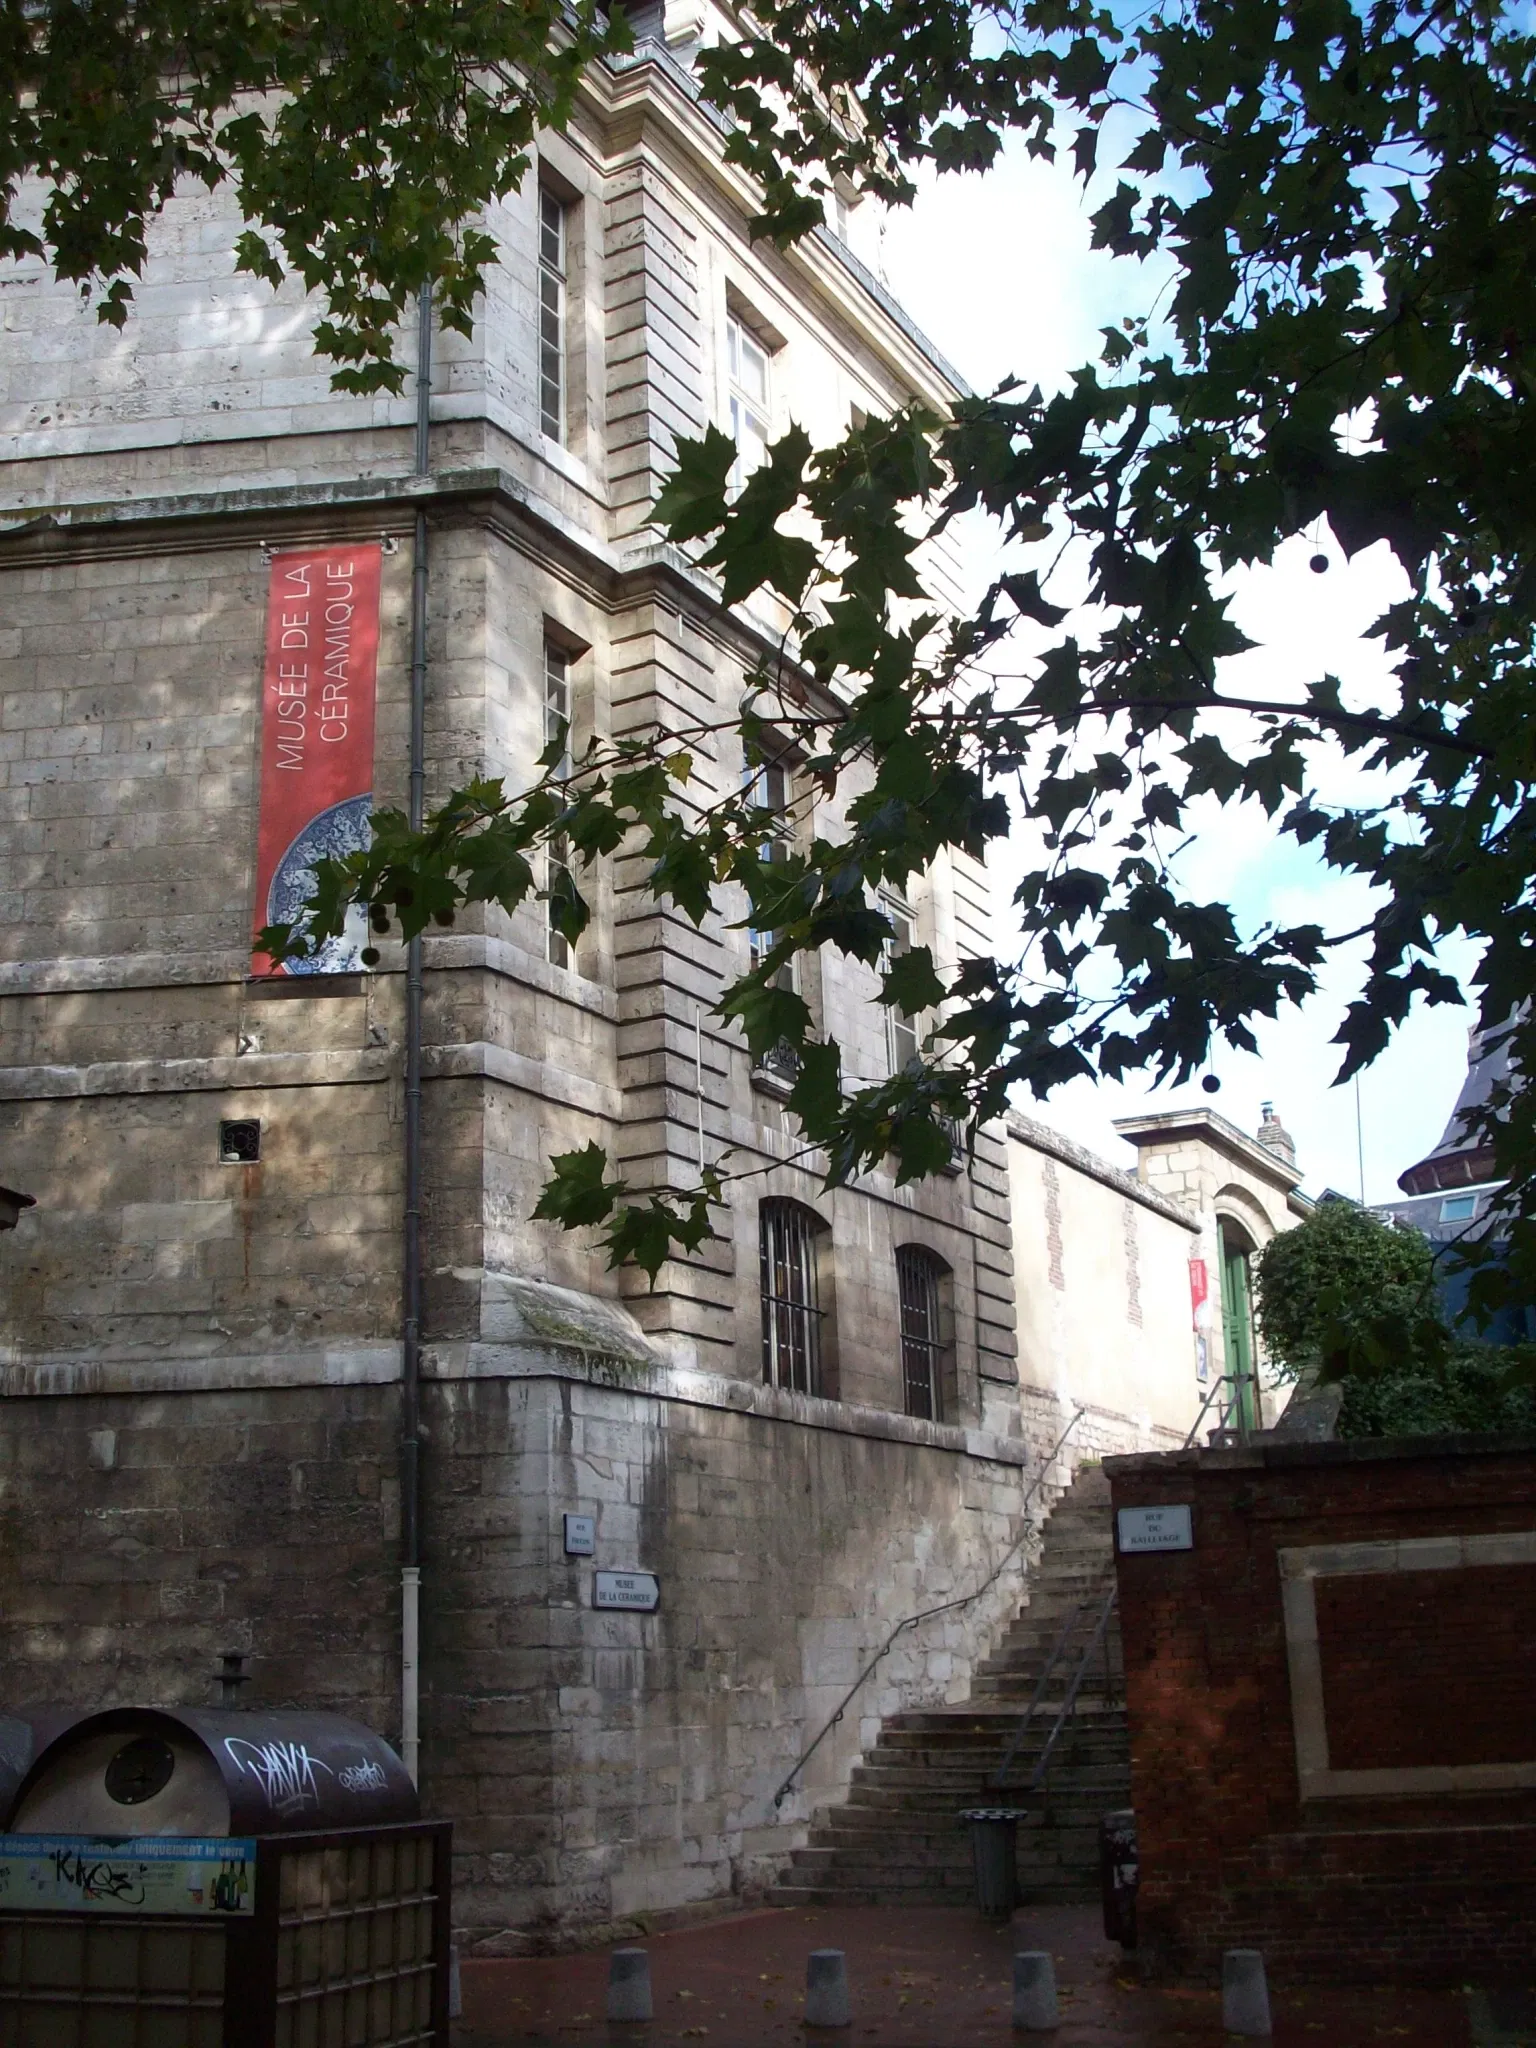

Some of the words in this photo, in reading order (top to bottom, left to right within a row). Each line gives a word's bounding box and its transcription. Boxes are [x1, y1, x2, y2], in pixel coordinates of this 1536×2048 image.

[284, 564, 312, 599] LA
[281, 611, 309, 649] DE
[314, 562, 355, 742] CÉRAMIQUE
[271, 663, 308, 770] MUSÉE
[599, 1591, 607, 1601] DE
[608, 1592, 617, 1601] LA
